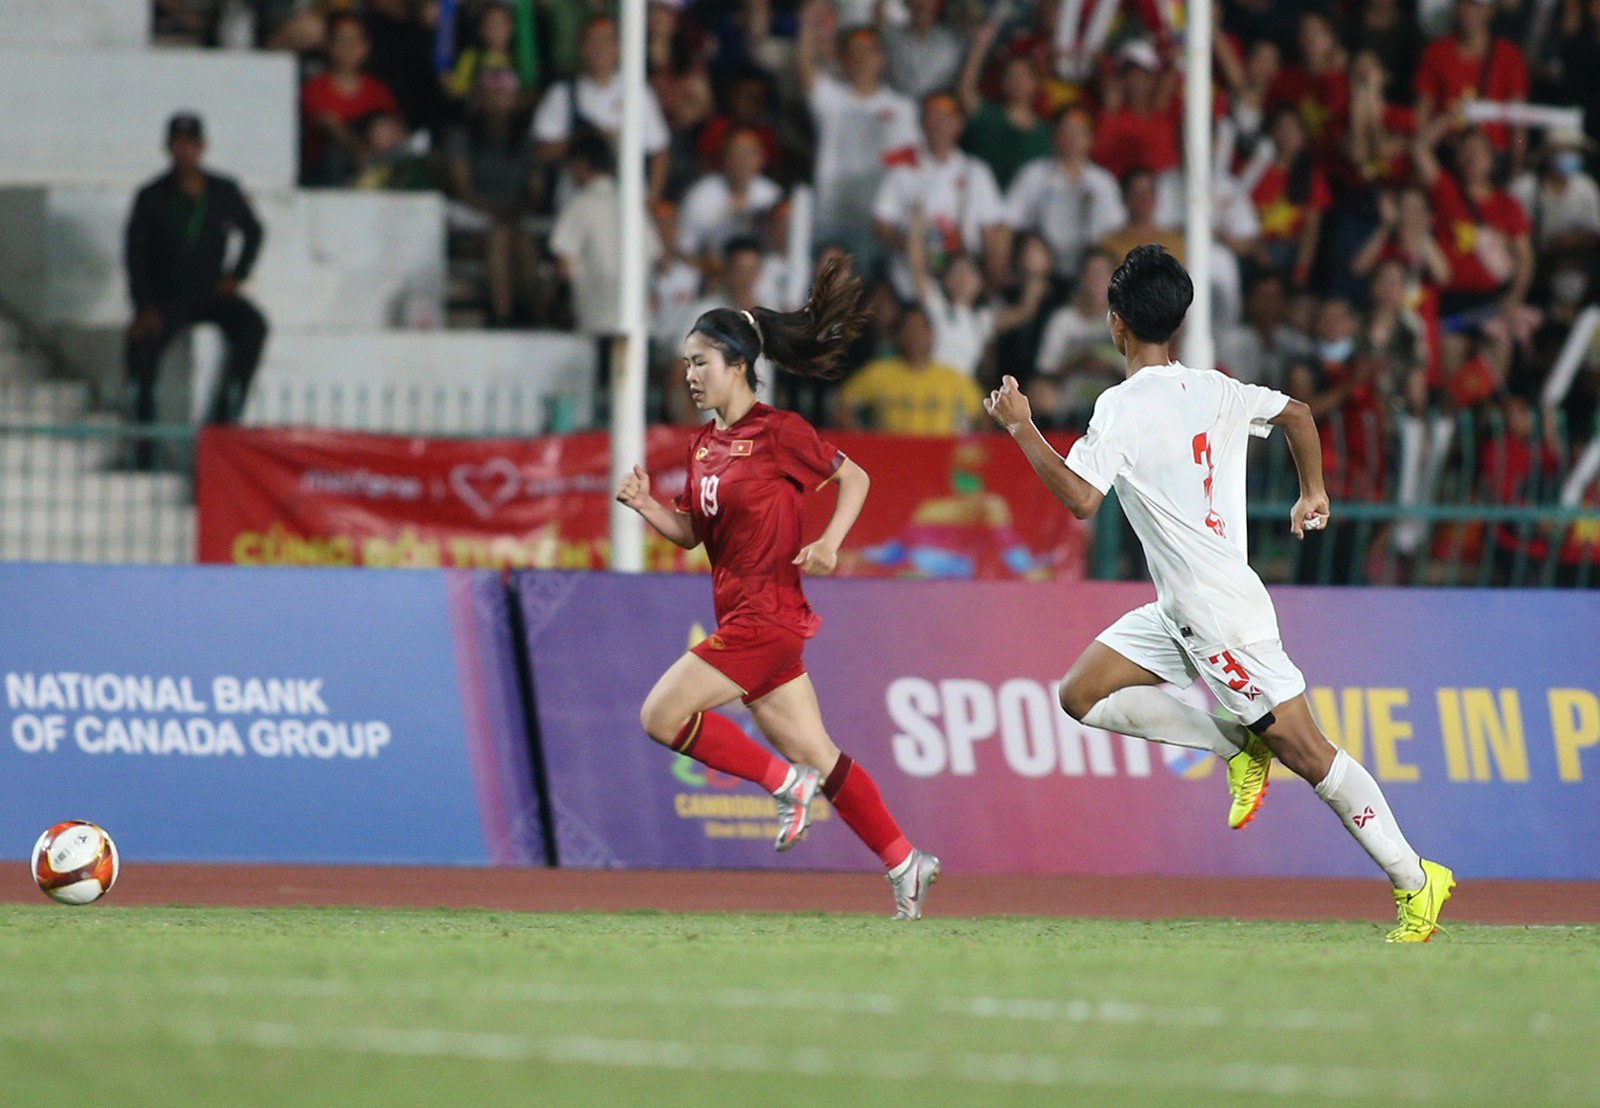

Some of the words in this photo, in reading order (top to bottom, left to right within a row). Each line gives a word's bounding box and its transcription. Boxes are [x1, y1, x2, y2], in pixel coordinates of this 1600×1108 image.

[700, 474, 720, 517] 19
[1208, 650, 1251, 692] 3
[5, 672, 207, 713] NATIONAL
[211, 676, 329, 715] BANK
[11, 713, 67, 753] OF
[73, 714, 246, 756] CANADA
[248, 718, 392, 758] GROUP
[1435, 686, 1531, 783] IN
